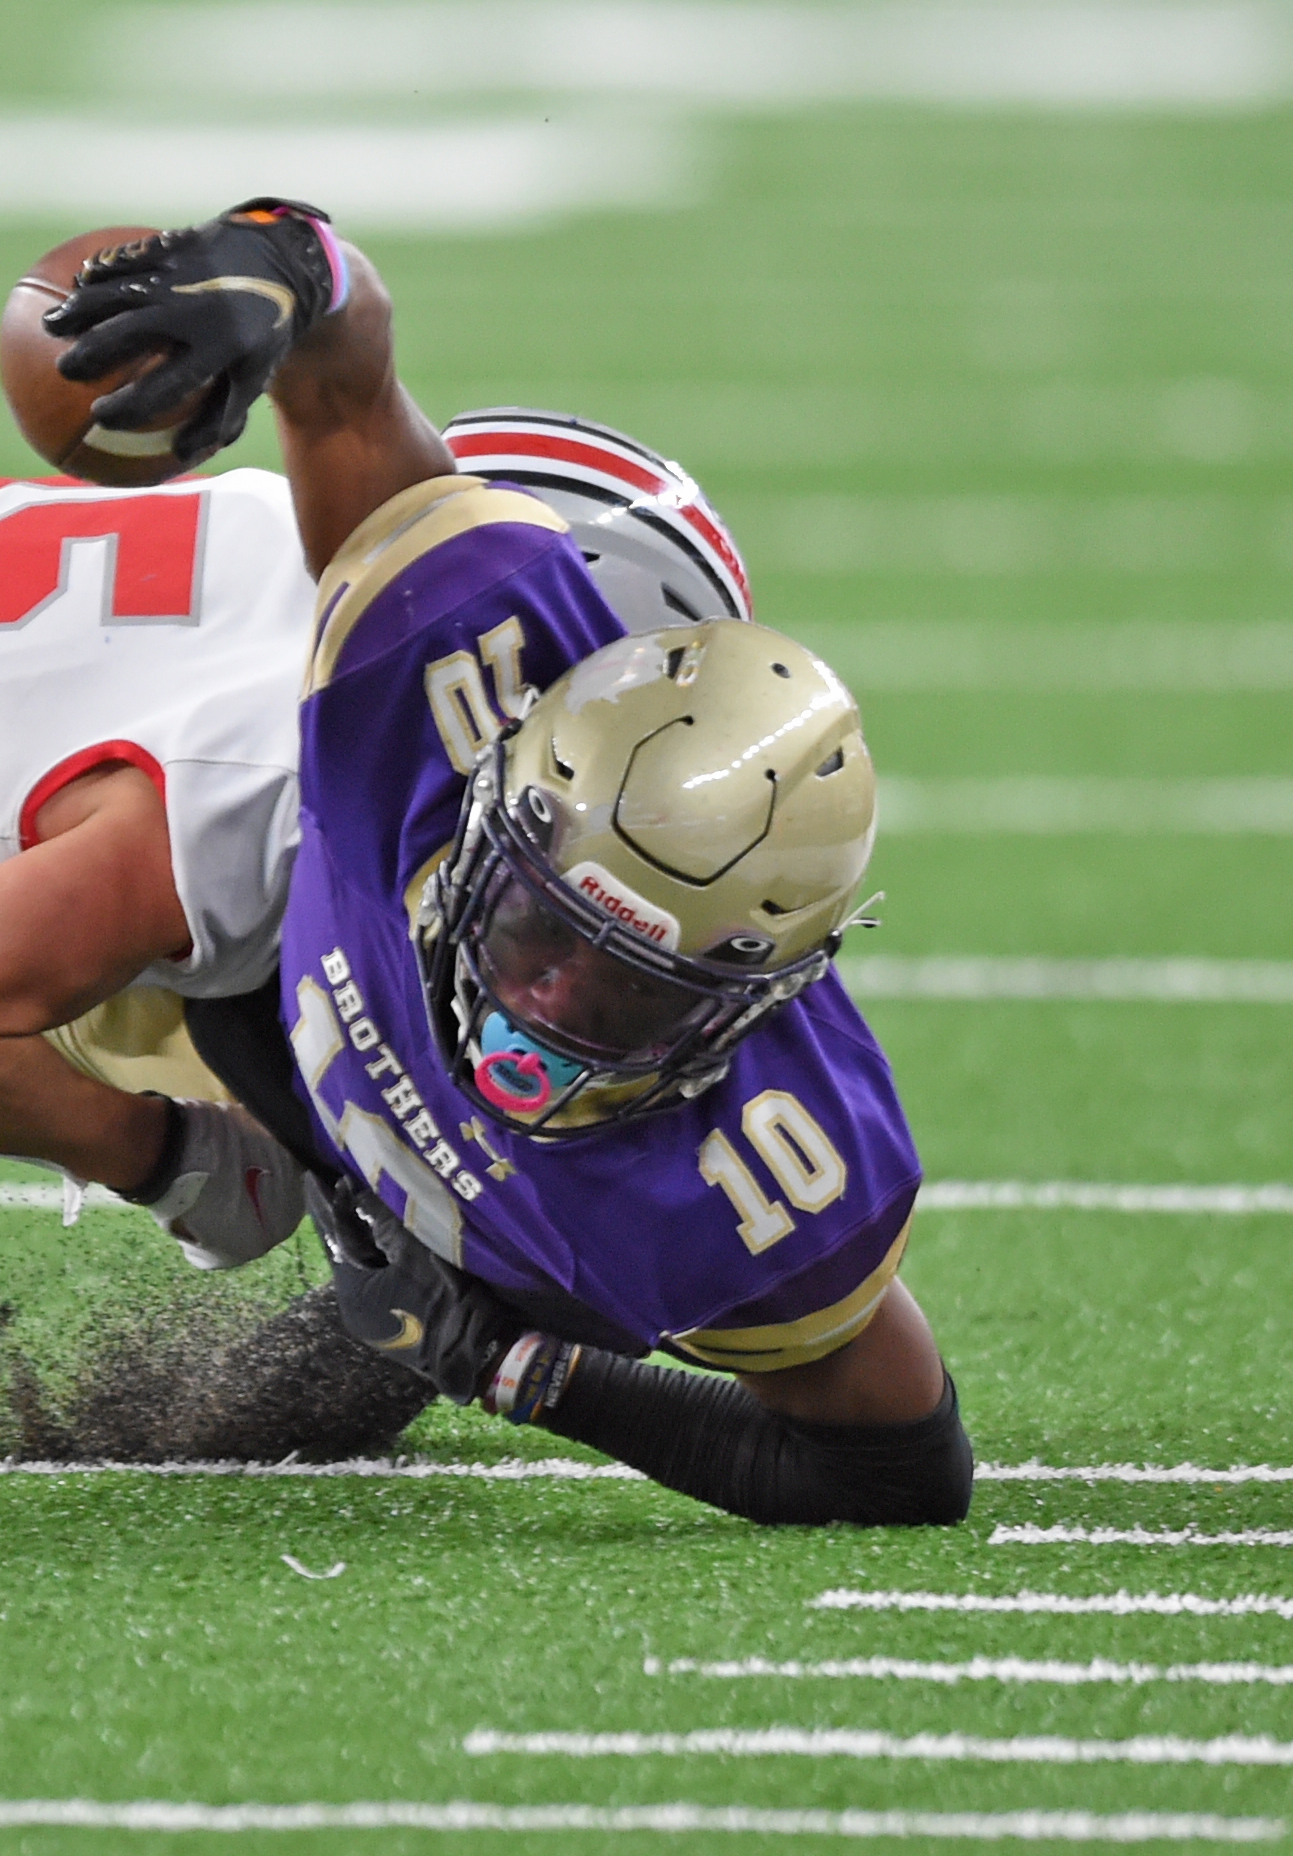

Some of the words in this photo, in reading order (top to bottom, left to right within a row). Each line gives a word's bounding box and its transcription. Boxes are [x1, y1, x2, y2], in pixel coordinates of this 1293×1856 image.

[423, 615, 526, 776] 10
[580, 876, 668, 942] Riddell
[320, 946, 483, 1202] BROTHERS
[698, 1089, 848, 1256] 10
